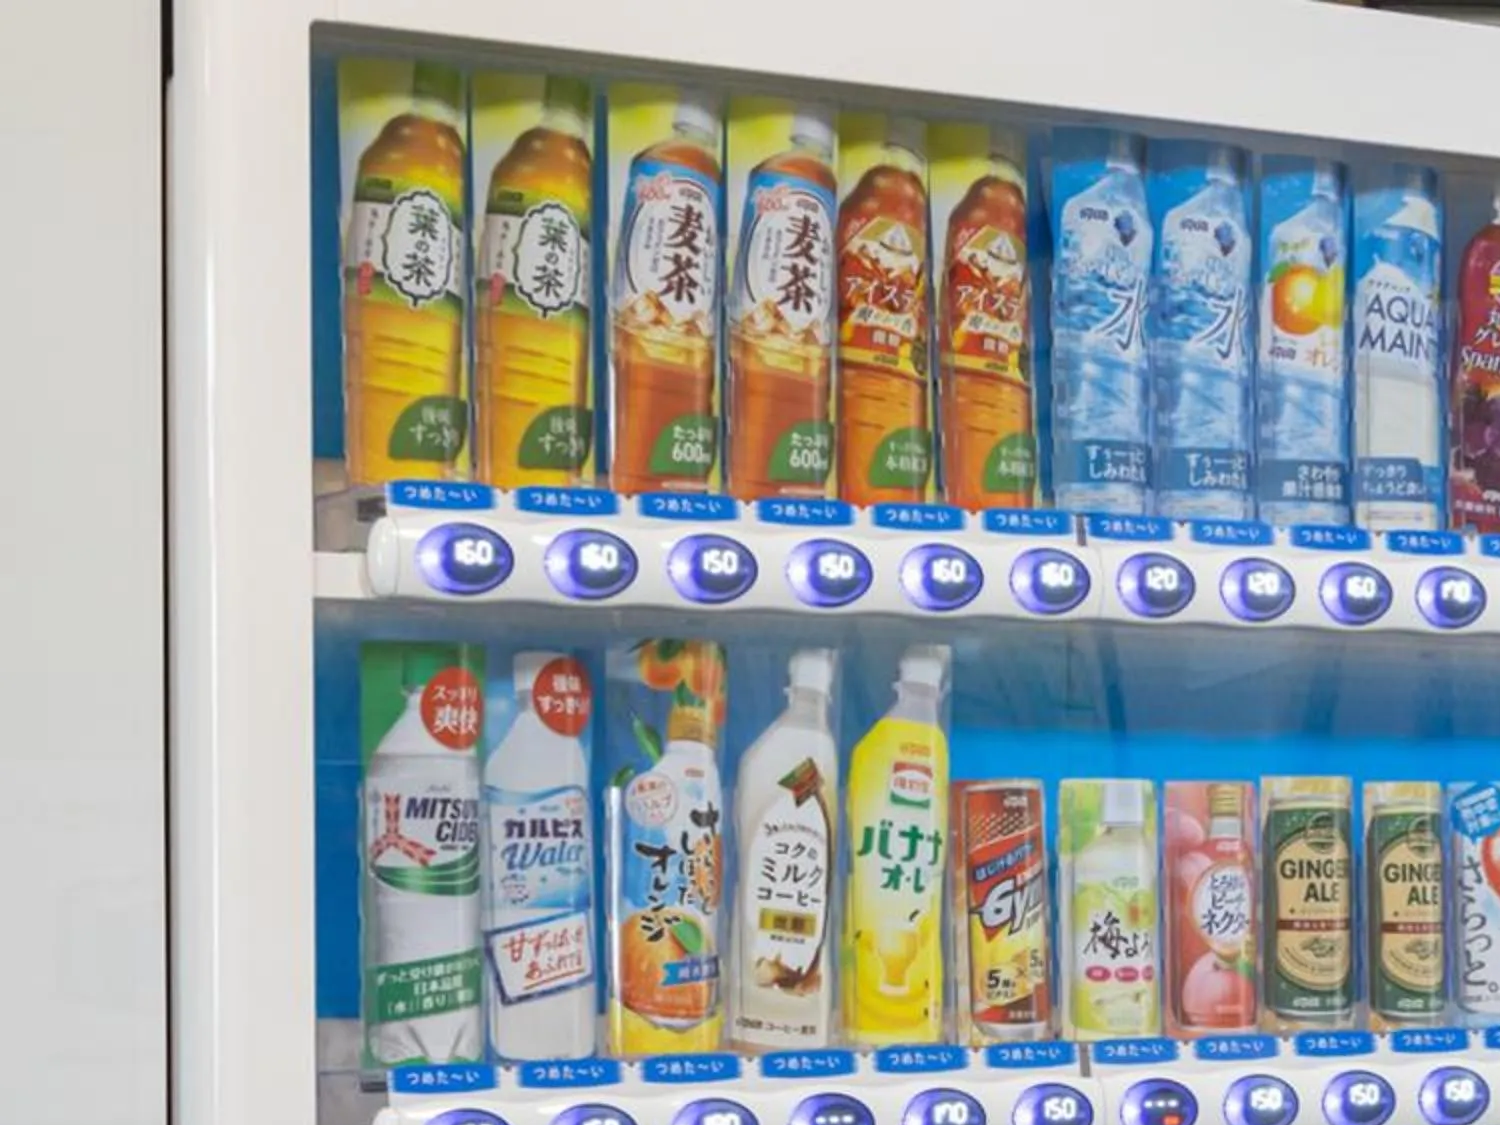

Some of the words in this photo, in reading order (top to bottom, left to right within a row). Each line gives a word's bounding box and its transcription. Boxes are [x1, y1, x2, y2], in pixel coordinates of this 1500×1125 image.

[402, 206, 440, 287] 葉の茶
[533, 217, 569, 299] 葉の茶
[660, 206, 703, 304] 麦茶
[777, 217, 820, 314] 麦茶
[1360, 330, 1436, 361] MAIN
[703, 549, 738, 575] 150
[932, 559, 966, 583] 160
[1146, 567, 1178, 591] 120
[1248, 571, 1280, 596] 120
[504, 818, 584, 839] カルピス
[761, 857, 823, 887] ミルク
[1280, 859, 1347, 880] GINGE
[1384, 863, 1442, 884] GINGE
[757, 887, 822, 907] コーヒー
[1304, 882, 1340, 903] ALE
[1407, 886, 1439, 906] ALE
[1349, 1083, 1380, 1106] 150
[1044, 1097, 1076, 1120] 150
